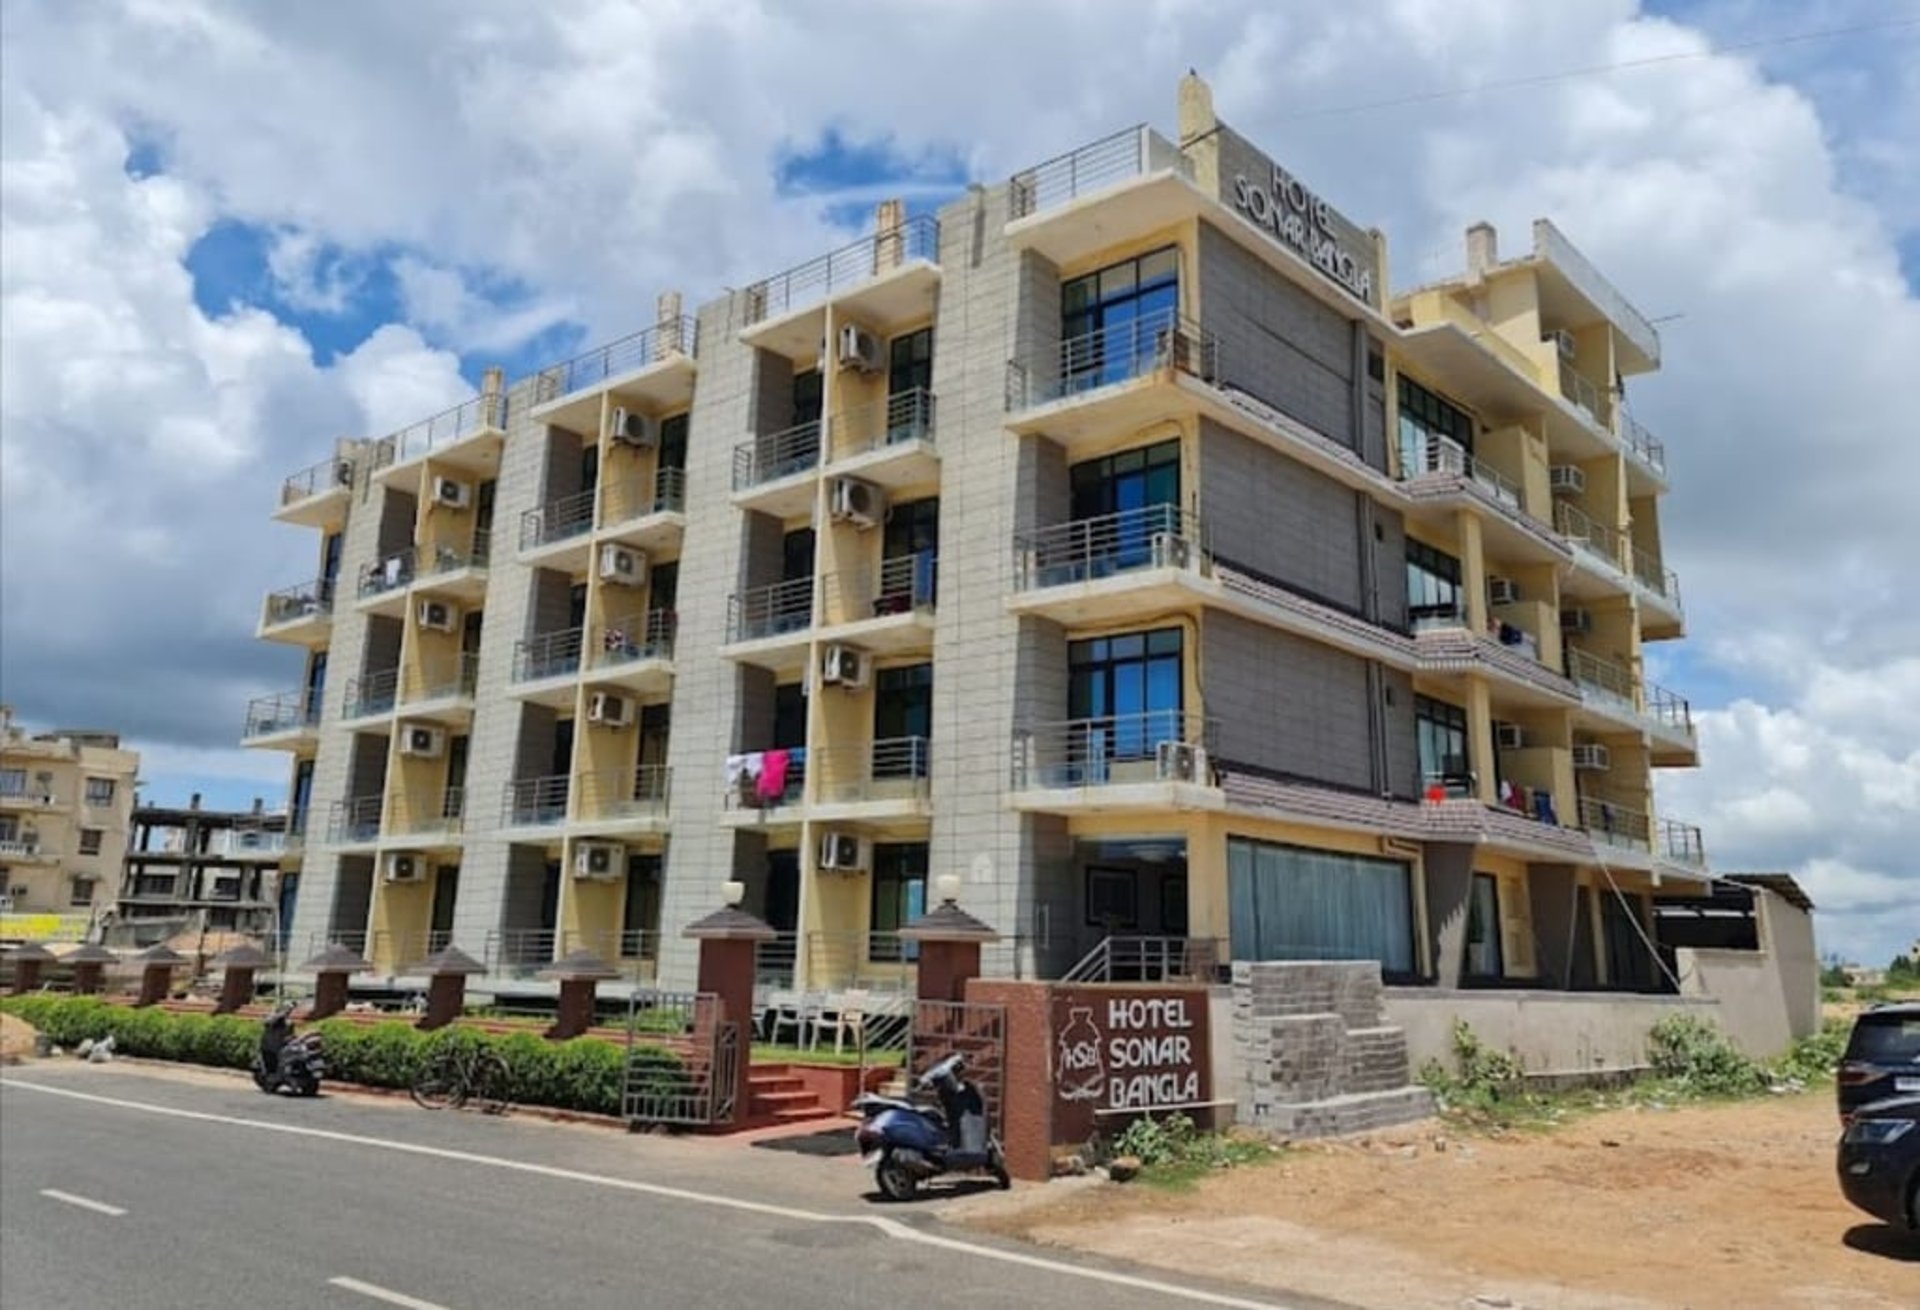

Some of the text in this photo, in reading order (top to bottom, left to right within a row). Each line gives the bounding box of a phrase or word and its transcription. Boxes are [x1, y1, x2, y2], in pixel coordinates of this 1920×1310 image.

[1270, 162, 1336, 237] HOTEL
[1235, 174, 1370, 301] SONAR BANGLA
[1108, 999, 1192, 1029] HOTEL
[1109, 1036, 1192, 1069] SONAR
[1109, 1071, 1199, 1109] BANGLA
